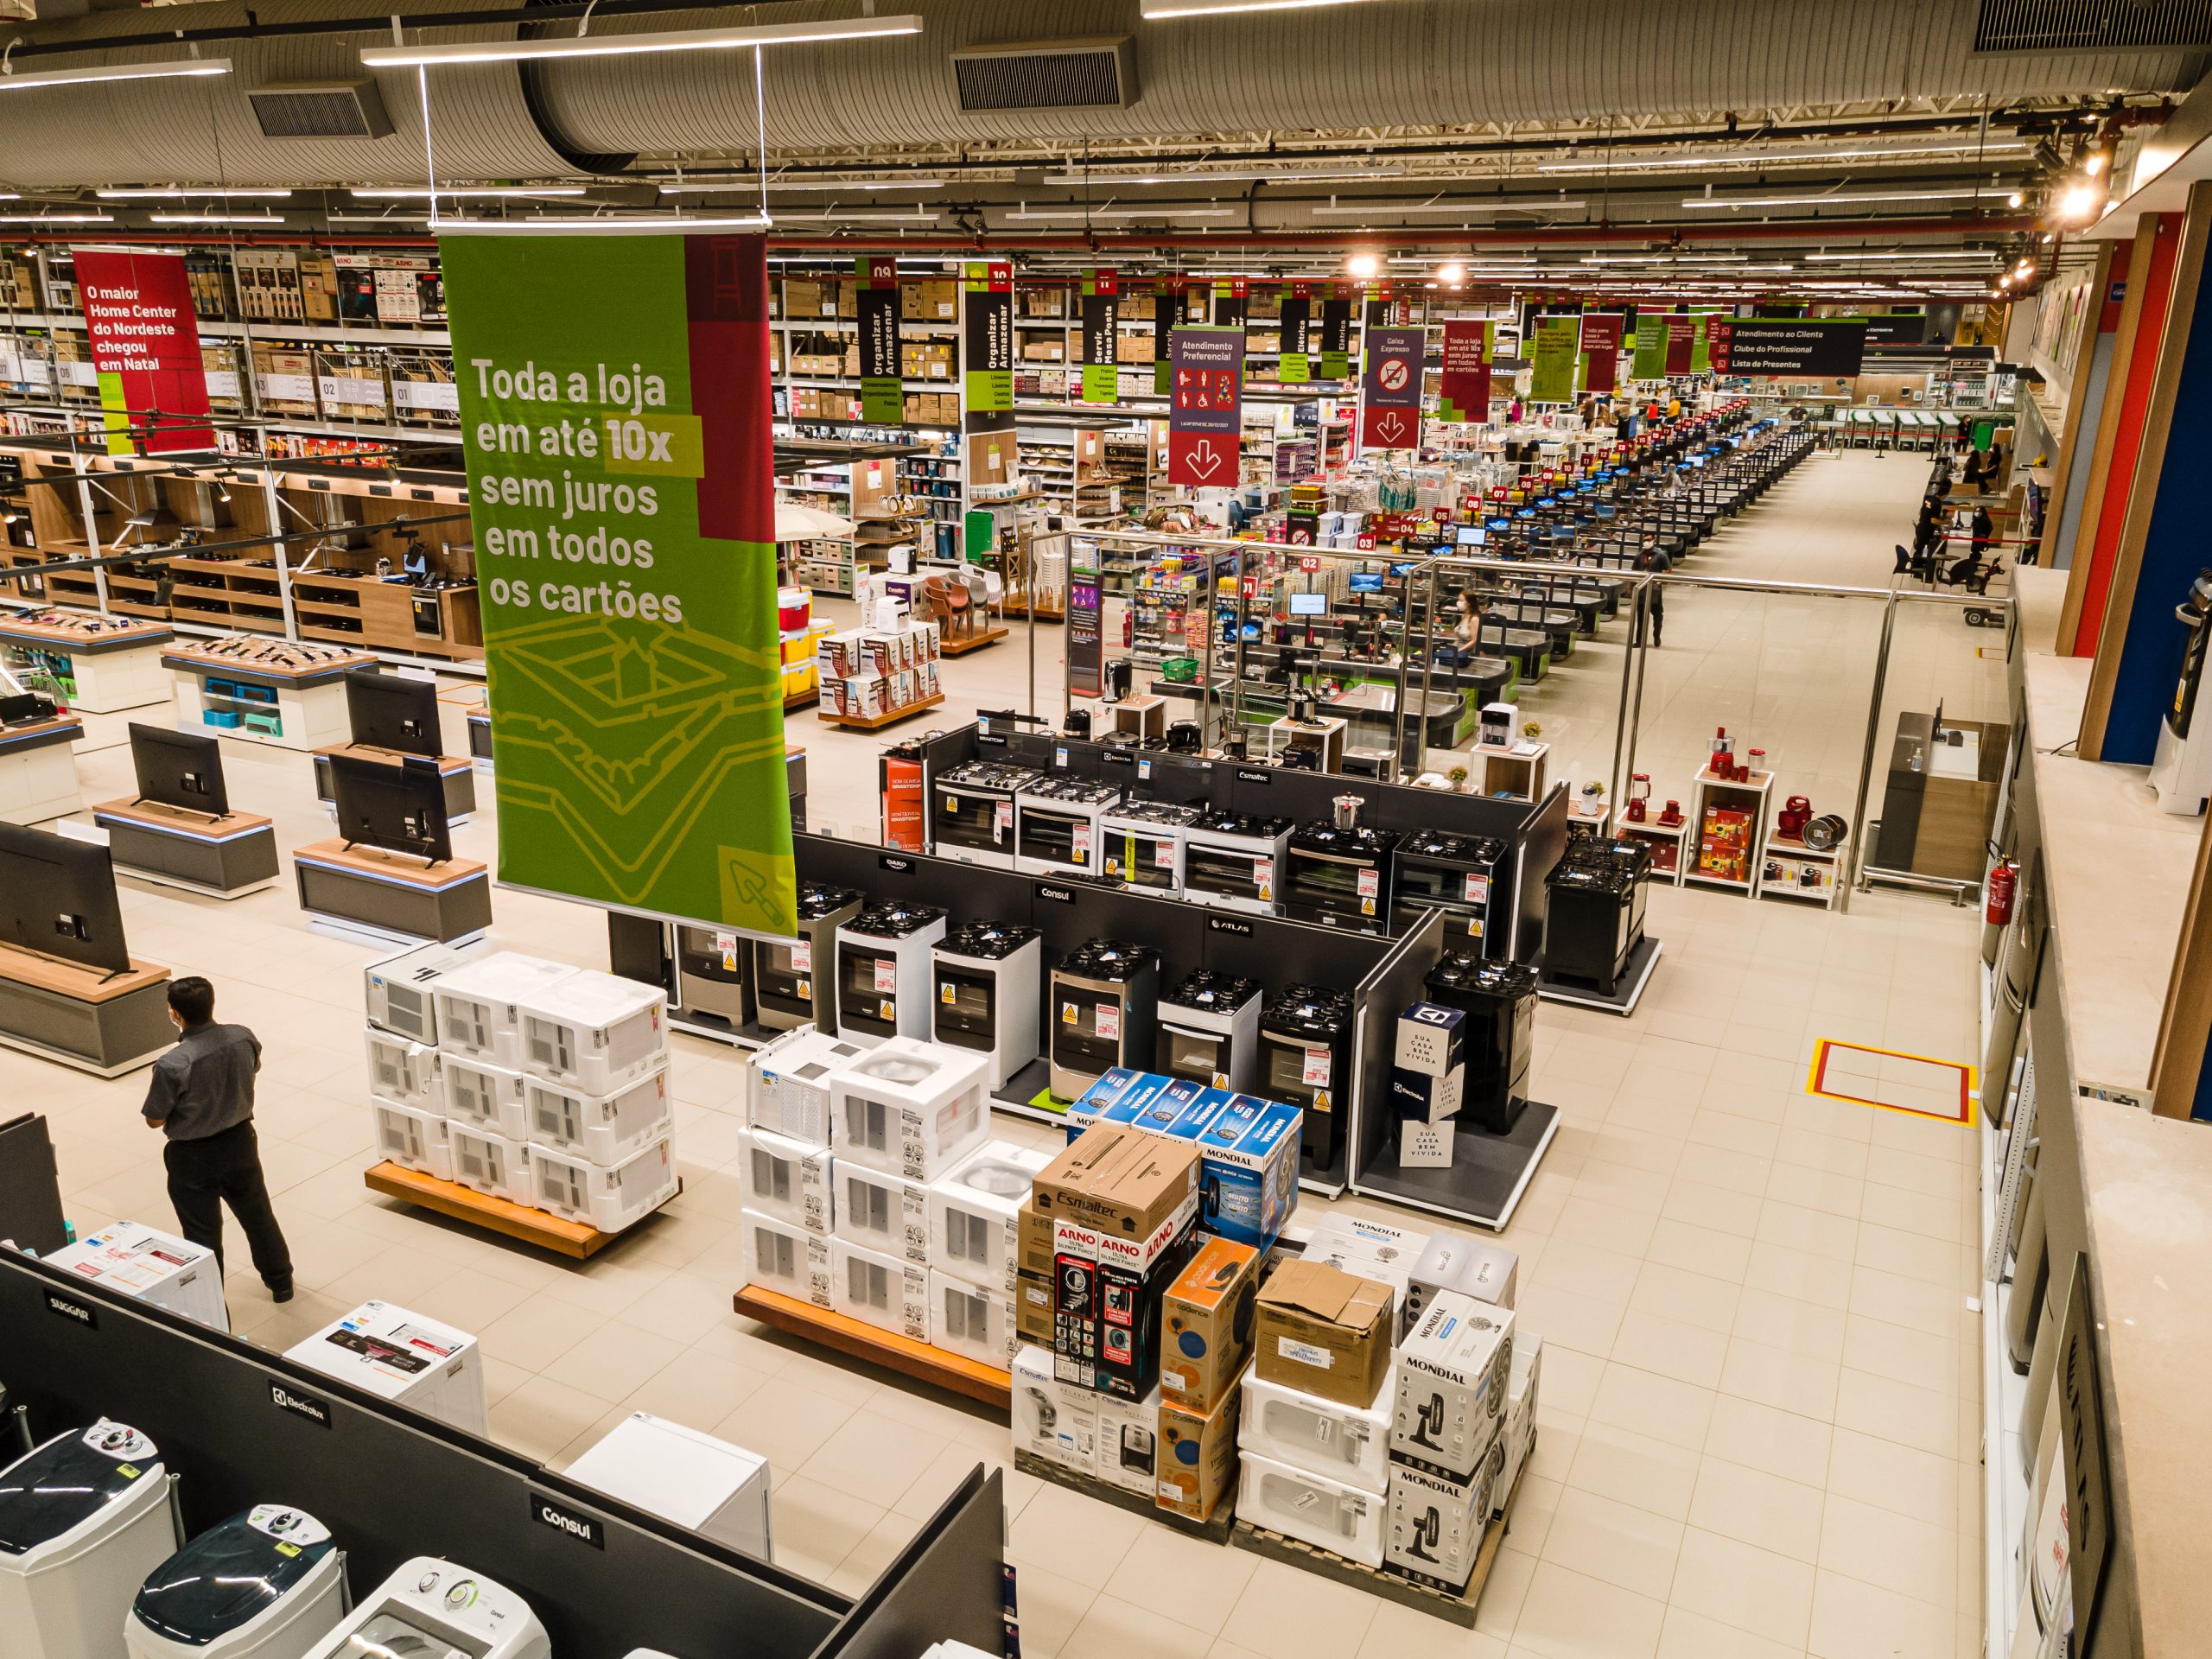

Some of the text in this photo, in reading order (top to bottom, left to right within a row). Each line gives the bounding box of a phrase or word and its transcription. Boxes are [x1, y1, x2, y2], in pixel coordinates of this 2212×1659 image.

[994, 270, 1007, 284] 10
[87, 286, 139, 300] O maior
[90, 304, 177, 319] Home Center
[93, 322, 175, 335] do Nordeste
[1104, 305, 1113, 364] Mesa Posta
[1796, 330, 1824, 339] Cliente
[885, 303, 895, 375] Armazenar
[988, 312, 999, 369] Organizar
[999, 304, 1008, 369] Armazenar
[97, 340, 147, 356] chegou
[872, 313, 884, 375] Organizar
[1094, 331, 1103, 364] Servir
[1181, 340, 1233, 351] Atendimento
[1183, 352, 1231, 361] Preferencial
[99, 358, 160, 371] em Natal
[1732, 359, 1751, 368] Lista
[60, 367, 71, 378] 06
[323, 384, 335, 396] 02
[471, 359, 666, 416] Toda a loja
[397, 389, 409, 401] 01
[477, 417, 673, 462] em até 10x
[1521, 480, 1531, 489] 08
[480, 470, 658, 519] sem juros
[1493, 489, 1505, 498] 07
[1467, 499, 1478, 509] 06
[1436, 512, 1447, 520] 05
[1401, 524, 1414, 534] 04
[485, 525, 654, 569] em todos
[1358, 538, 1372, 549] 03
[1302, 557, 1317, 569] 02
[490, 578, 683, 623] os cartões
[1239, 772, 1268, 782] Esmaltec
[887, 859, 906, 868] DAKO
[1041, 887, 1069, 900] Consul
[1221, 922, 1249, 933] ATLAS
[1410, 1040, 1433, 1050] CASA
[1414, 1034, 1431, 1043] SUA
[1413, 1047, 1430, 1056] BEM
[1406, 1053, 1436, 1065] VIVIDA
[1129, 1086, 1156, 1109] MONDIAL
[1402, 1087, 1424, 1102] Electrolux
[1440, 1086, 1454, 1096] CASA
[1437, 1098, 1456, 1110] VIVIDA
[1192, 1102, 1219, 1125] MONDIAL
[1261, 1118, 1287, 1142] MONDIAL
[1206, 1148, 1253, 1166] MONDIAL
[1228, 1192, 1249, 1204] MUITO
[1057, 1192, 1118, 1219] Esmaltec
[1228, 1202, 1249, 1212] VENTO
[1058, 1228, 1096, 1244] ARNO
[1351, 1221, 1402, 1238] MONDIAL
[1057, 1243, 1077, 1252] SILENCE
[1101, 1239, 1140, 1256] ARNO
[1146, 1221, 1173, 1262] ARNO
[1101, 1254, 1121, 1264] SILENCE
[50, 1298, 89, 1321] SUGGAR
[1176, 1304, 1209, 1319] cadence
[1420, 1308, 1446, 1340] MONDIAL
[1020, 1368, 1049, 1383] Esmaltec
[1406, 1357, 1466, 1386] MONDIAL
[287, 1395, 324, 1421] Electrolux
[1102, 1395, 1128, 1408] Esmaltec
[1172, 1414, 1205, 1427] cadence
[1401, 1471, 1461, 1498] MONDIAL
[542, 1507, 591, 1541] Consul
[490, 1609, 505, 1619] Consul
